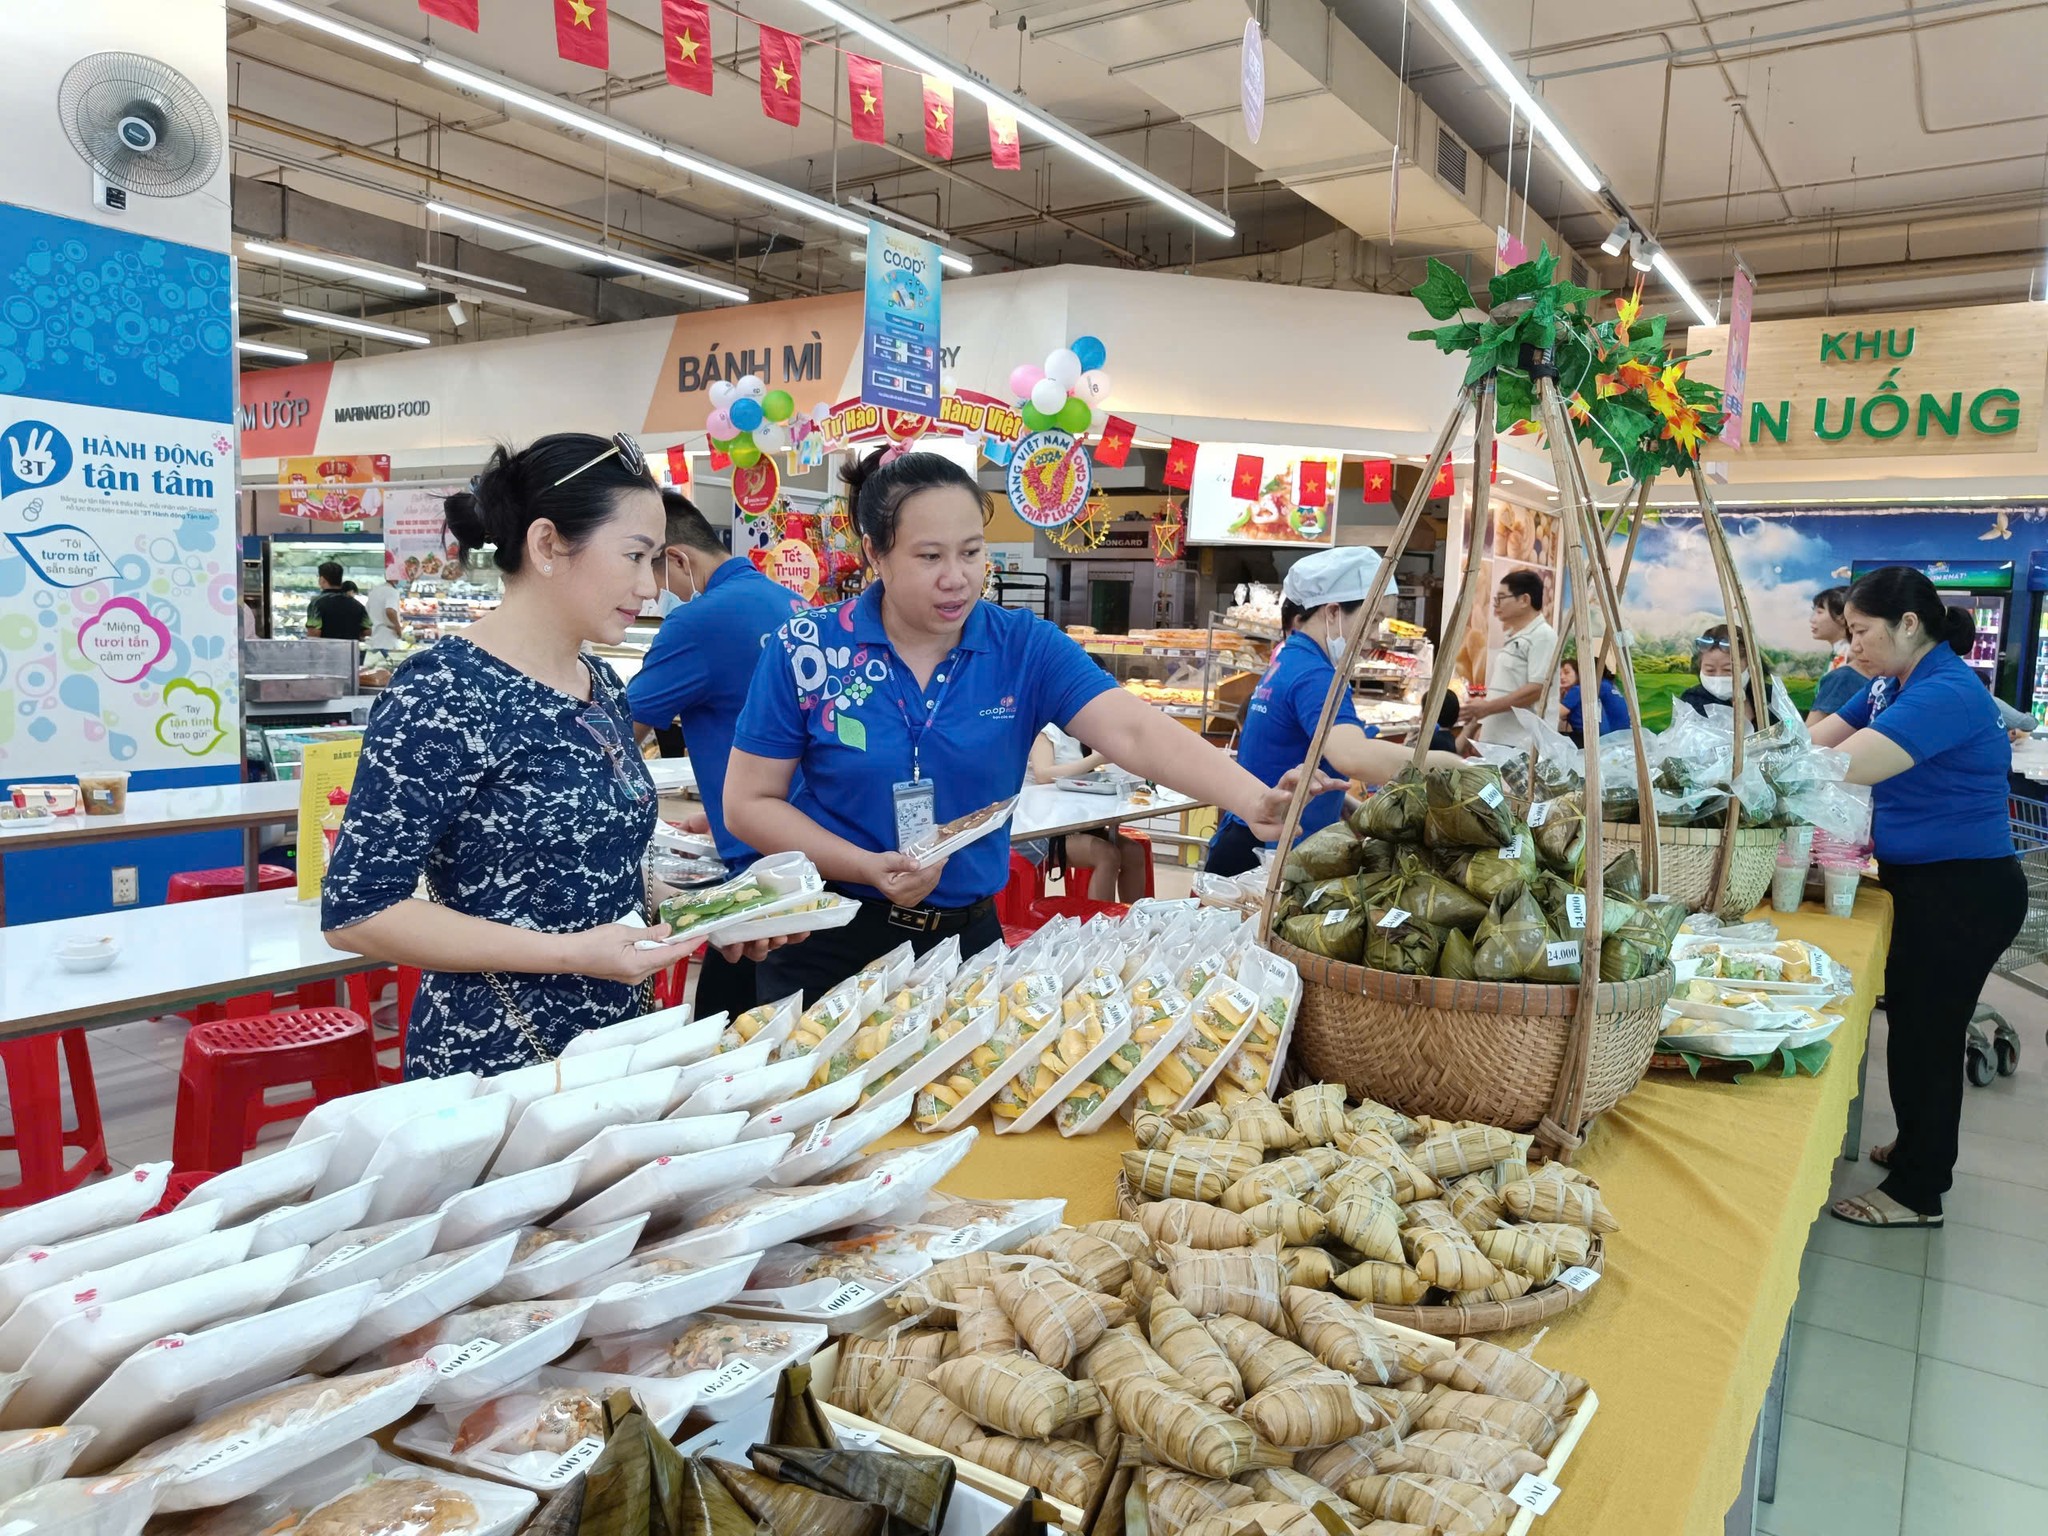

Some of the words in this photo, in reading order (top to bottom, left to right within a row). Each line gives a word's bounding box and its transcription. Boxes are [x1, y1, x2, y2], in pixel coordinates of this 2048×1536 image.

[1820, 327, 1915, 362] KHU
[678, 343, 770, 393] BÁNH
[783, 331, 823, 383] MÌ
[262, 391, 309, 430] ƯỚP
[335, 404, 395, 423] MARINATED
[398, 400, 430, 417] FOOD
[940, 397, 984, 430] Hàng
[986, 407, 1022, 441] Việt
[1814, 367, 2020, 441] UỐNG
[822, 414, 842, 441] Tự
[845, 407, 877, 433] Hào
[82, 434, 146, 460] HÀNH
[154, 443, 214, 468] ĐỘNG
[1044, 435, 1070, 450] NAM
[20, 459, 46, 476] 3T
[82, 463, 139, 496] tận
[152, 469, 214, 498] tâm
[1074, 455, 1086, 482] CAO
[42, 550, 80, 561] tươm
[84, 550, 101, 562] tất
[774, 564, 810, 580] Trung
[95, 637, 124, 648] tươi
[1574, 896, 1585, 928] 24.000
[1548, 948, 1577, 961] 24.000
[828, 1284, 867, 1311] 15.000
[441, 1340, 490, 1375] 15.000
[704, 1362, 750, 1394] 15.000
[182, 1440, 250, 1475] 15.000
[550, 1442, 599, 1479] 15.000
